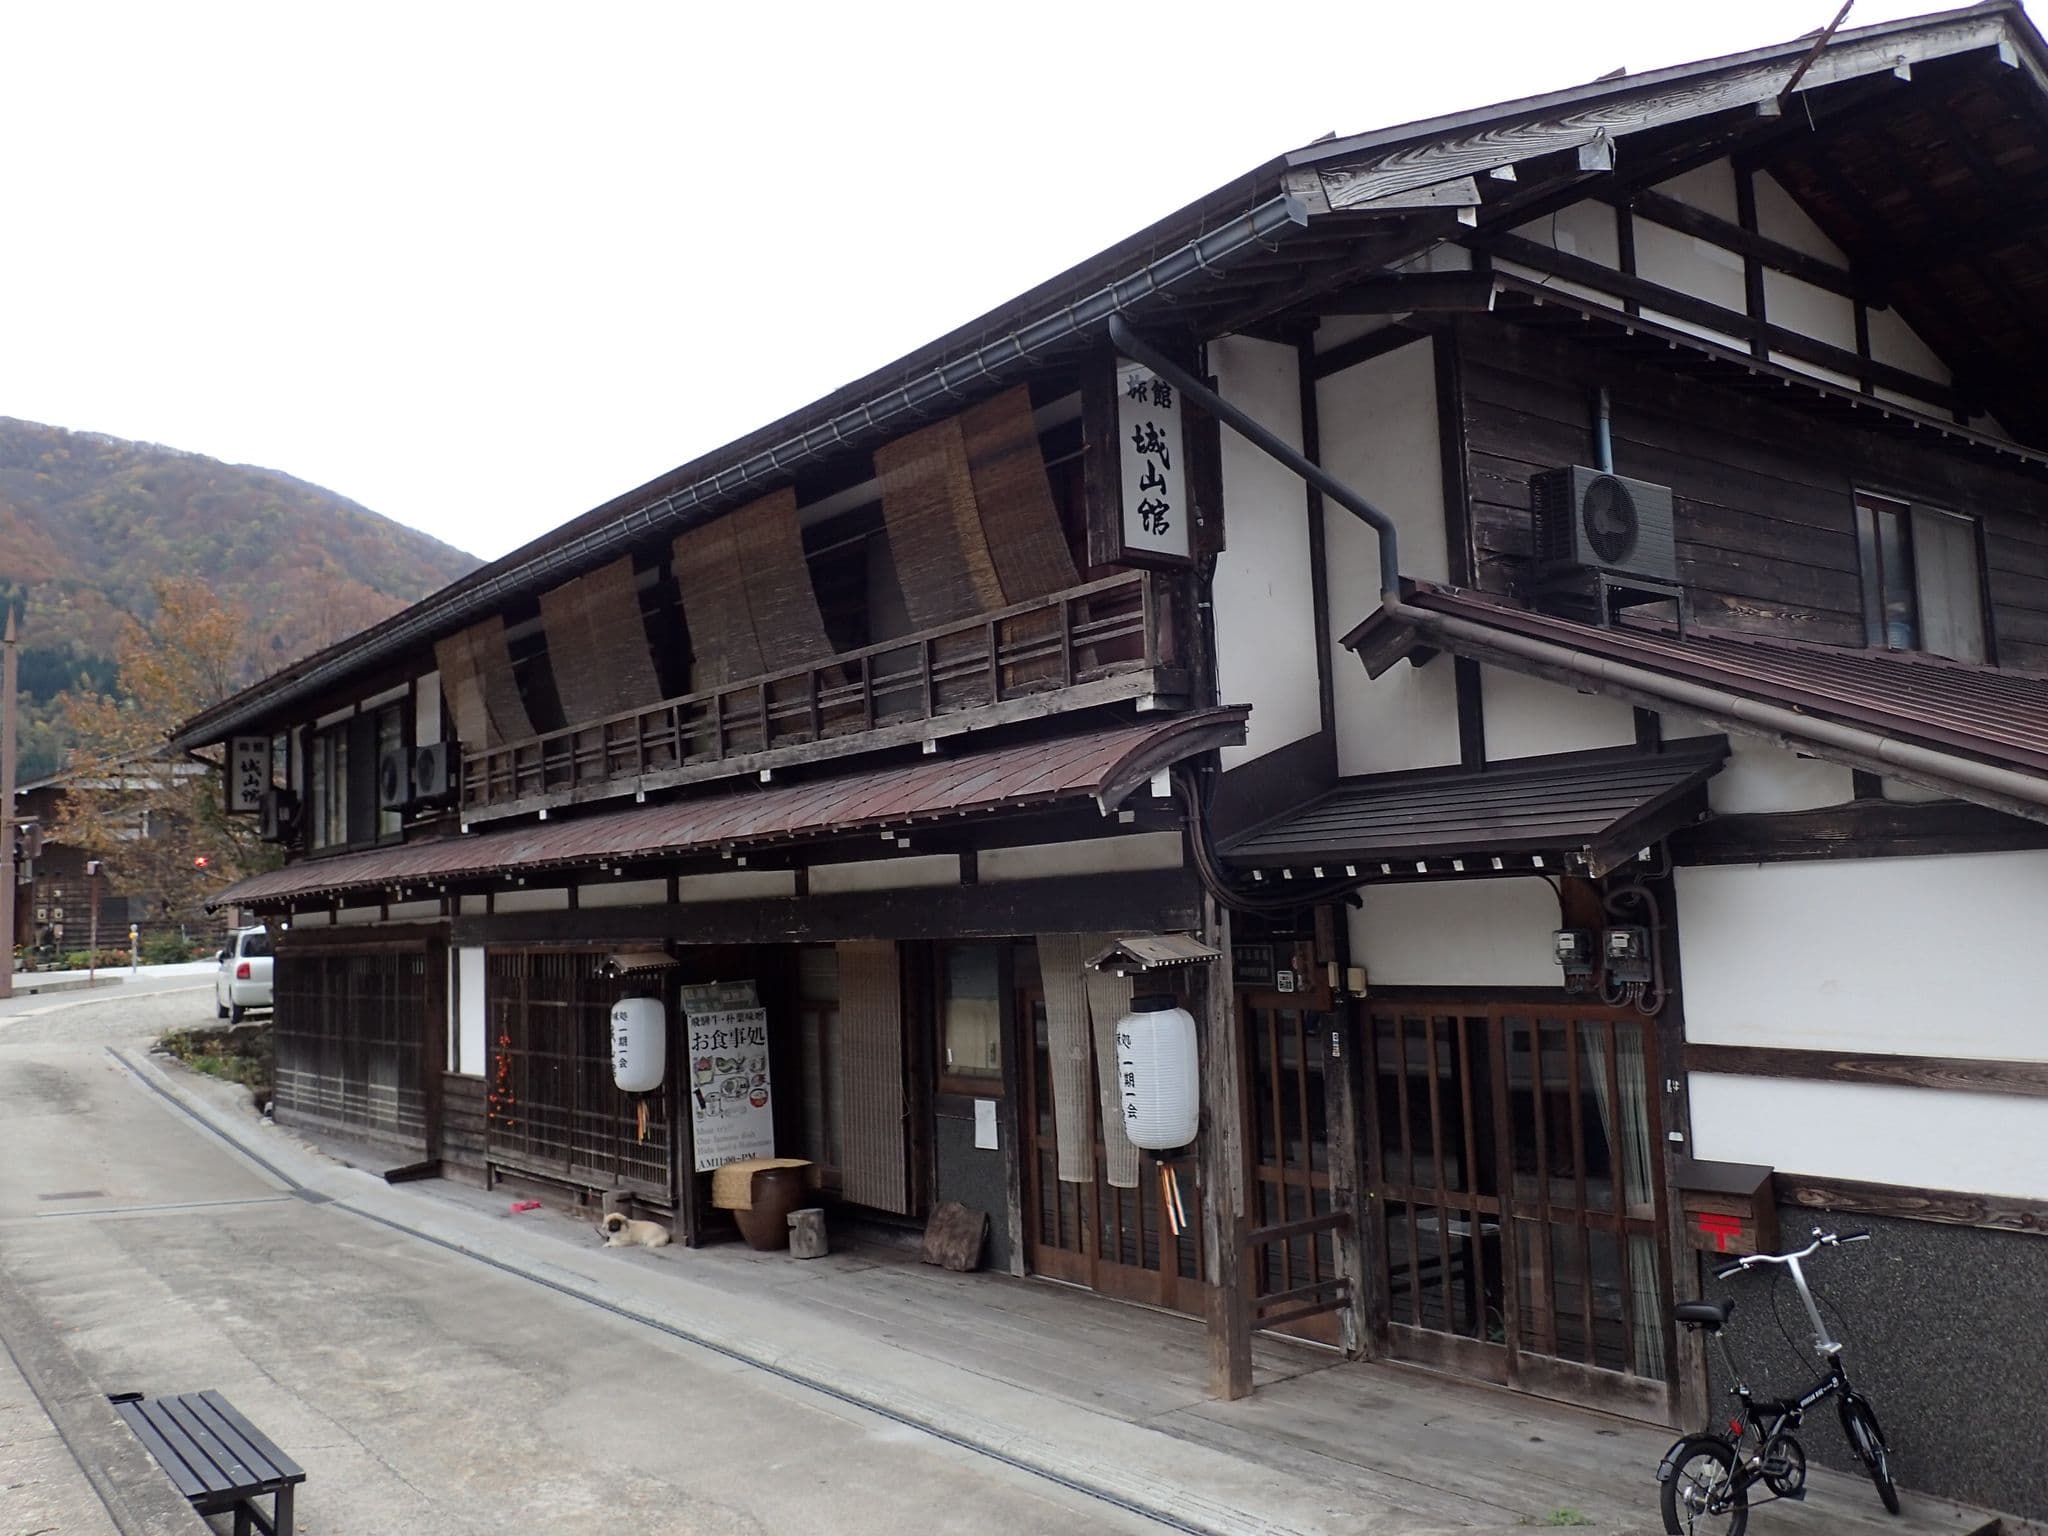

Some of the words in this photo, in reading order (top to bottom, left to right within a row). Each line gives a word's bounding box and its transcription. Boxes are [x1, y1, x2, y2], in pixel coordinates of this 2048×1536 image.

[1131, 421, 1171, 536] 城山館
[618, 1027, 628, 1068] 一期一会
[692, 1026, 766, 1051] お食事処
[1123, 1060, 1137, 1119] 一期一会
